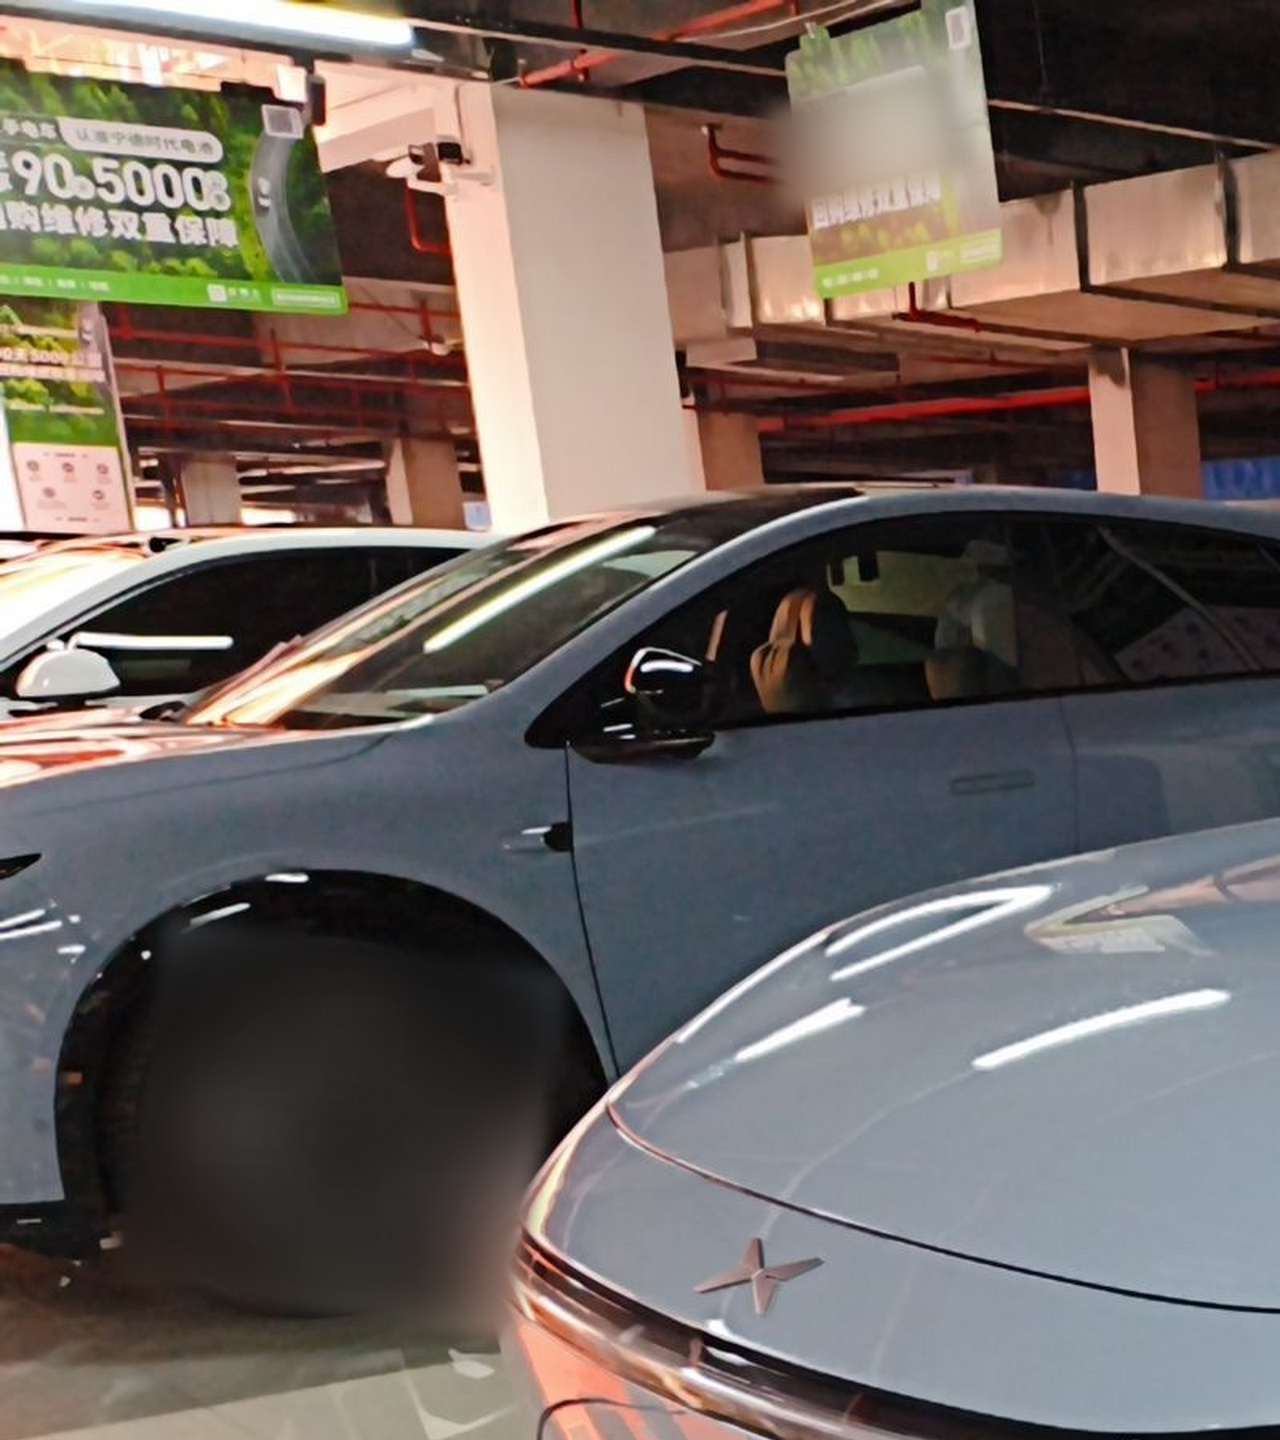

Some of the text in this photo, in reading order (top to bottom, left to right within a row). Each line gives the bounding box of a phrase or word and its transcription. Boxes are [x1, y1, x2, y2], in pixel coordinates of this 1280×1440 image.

[0, 199, 239, 248] 购维修双重保障
